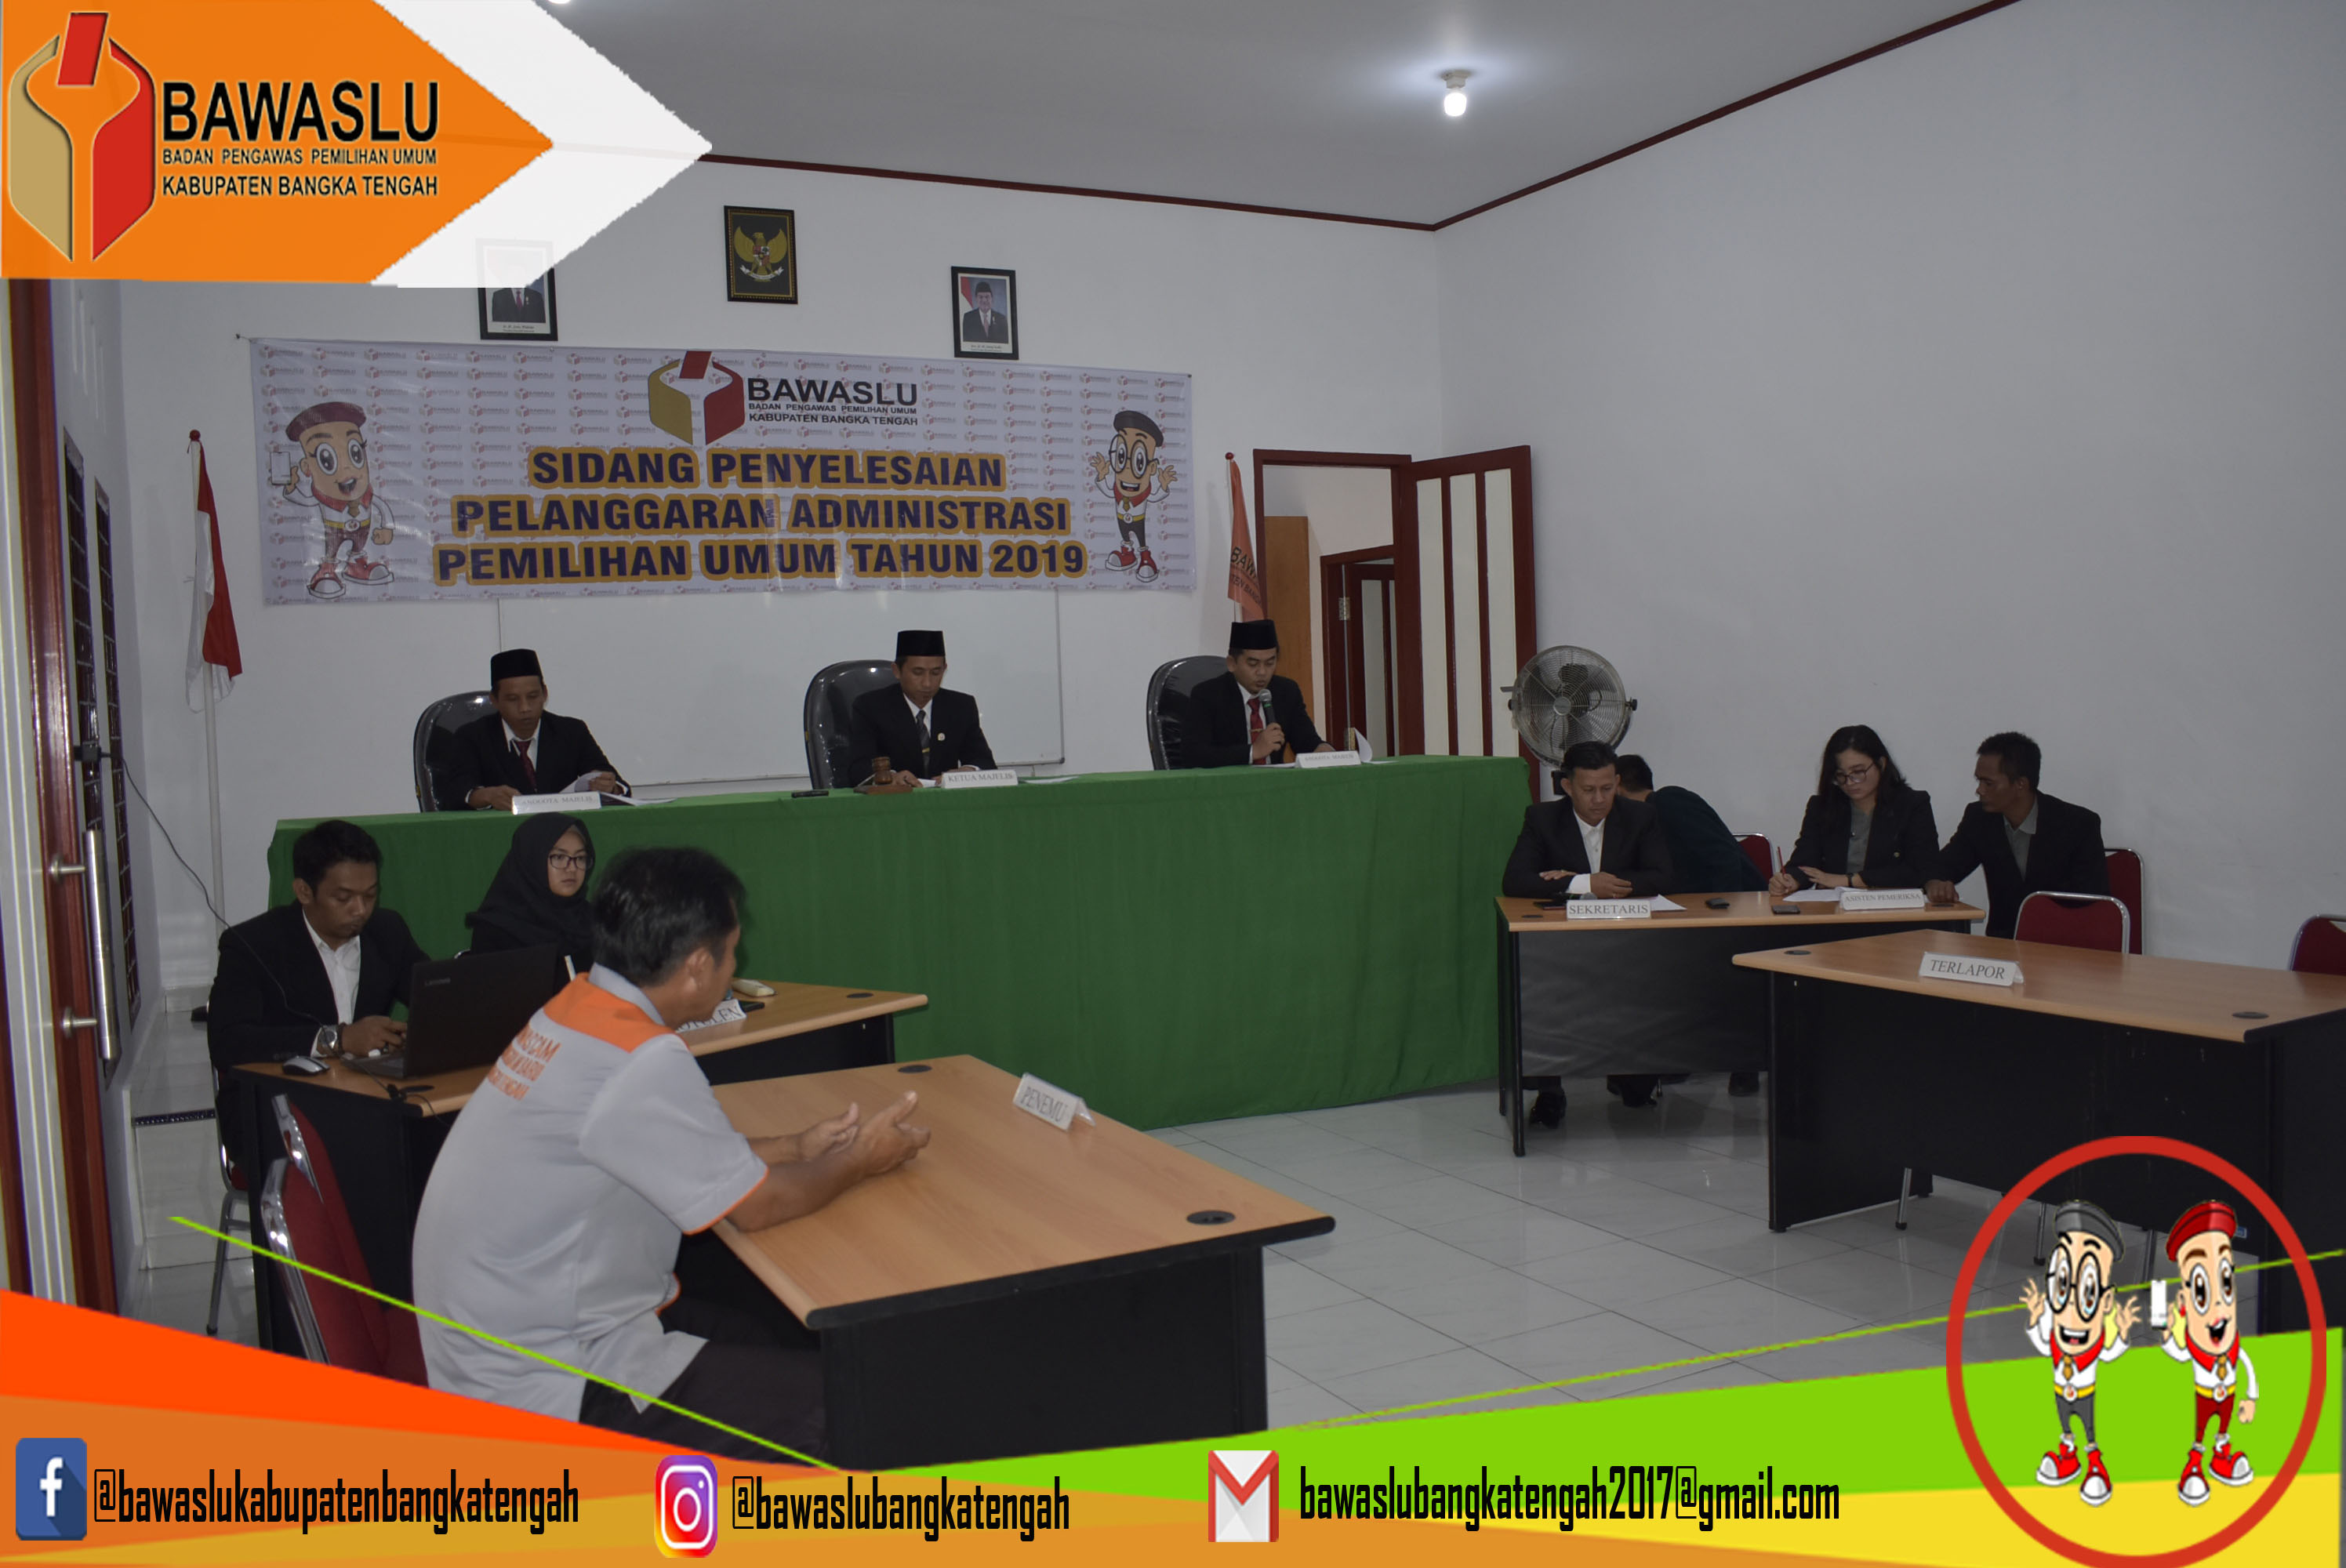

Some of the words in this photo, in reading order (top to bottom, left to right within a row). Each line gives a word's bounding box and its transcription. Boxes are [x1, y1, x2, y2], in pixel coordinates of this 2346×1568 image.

[747, 377, 917, 406] BAWASLU
[748, 402, 782, 411] BADAN
[786, 404, 837, 412] PENGAWAS
[841, 405, 888, 414] PEMILIHAN
[890, 406, 917, 415] UMUM
[749, 413, 819, 423] KABUPATEN
[822, 415, 871, 425] BANGKA
[872, 416, 918, 426] TENGAH
[533, 451, 695, 484] SIDANG
[711, 452, 1002, 487] PENYELESAIAN
[456, 498, 777, 532] PELANGGARAN
[792, 497, 1068, 532] ADMINISTRASI
[438, 546, 688, 580] PEMILIHAN
[704, 543, 837, 576] UMUM
[850, 543, 980, 574] TAHUN
[993, 544, 1084, 574] 2019
[978, 772, 1013, 781] MAJELIS
[1568, 904, 1649, 915] SEKRETARIS
[1930, 959, 2006, 980] TERLAPOR
[1020, 1085, 1069, 1123] PENEMU
